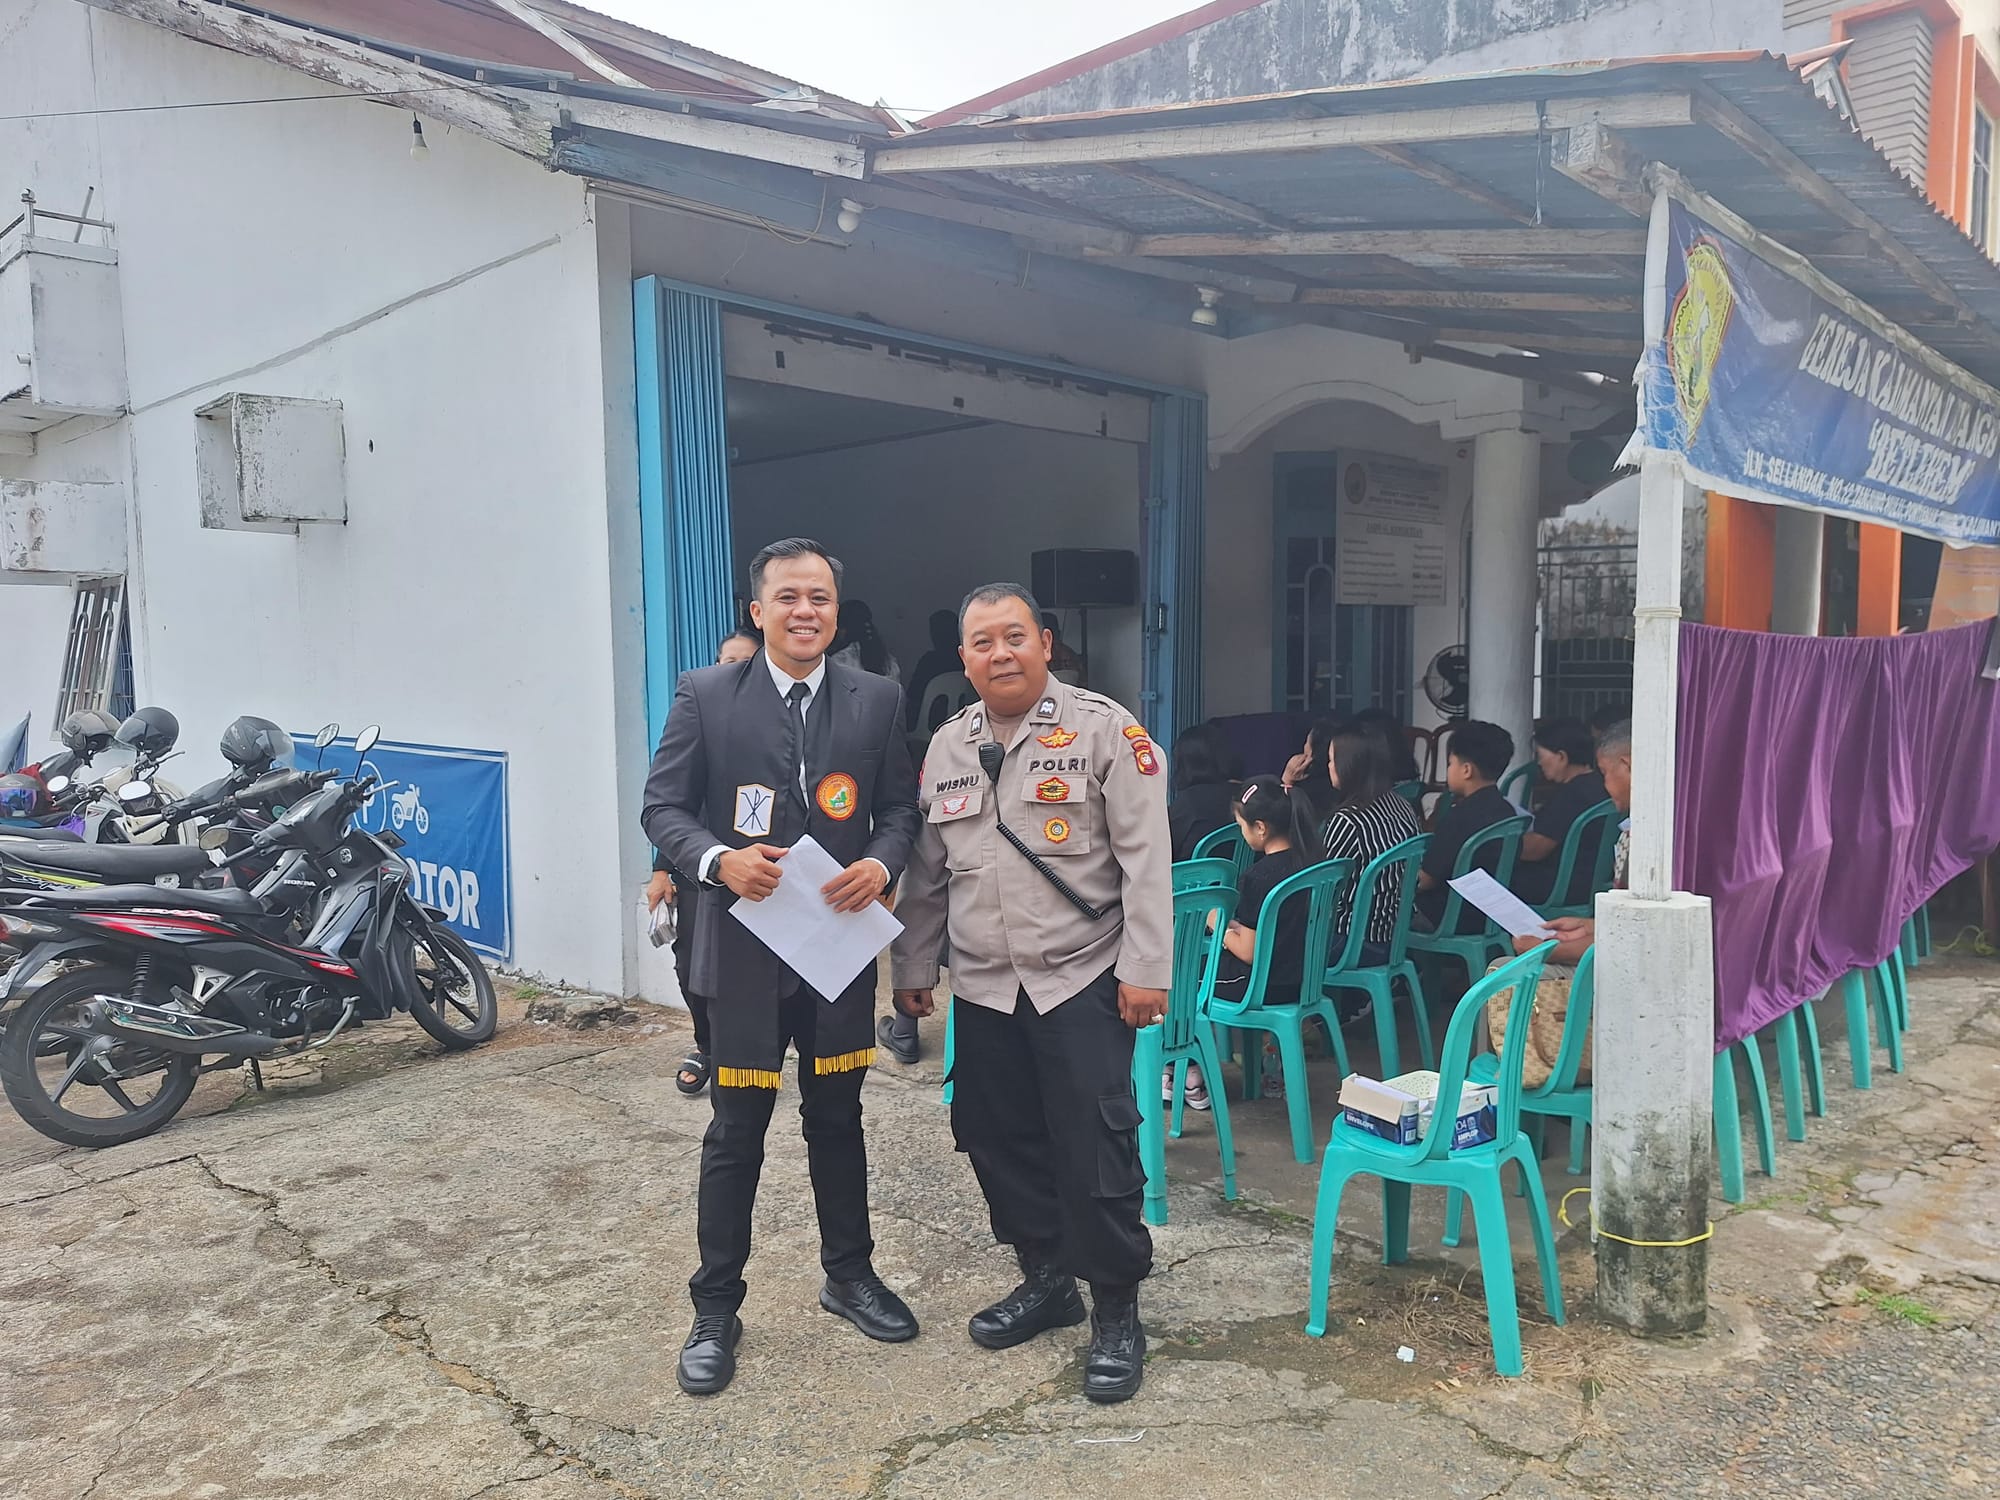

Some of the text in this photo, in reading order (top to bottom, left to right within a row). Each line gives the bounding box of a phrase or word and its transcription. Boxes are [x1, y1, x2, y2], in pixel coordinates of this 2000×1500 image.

[1798, 313, 1871, 399] GEREJA
[1029, 758, 1086, 771] POLRI
[936, 775, 979, 793] WISNU
